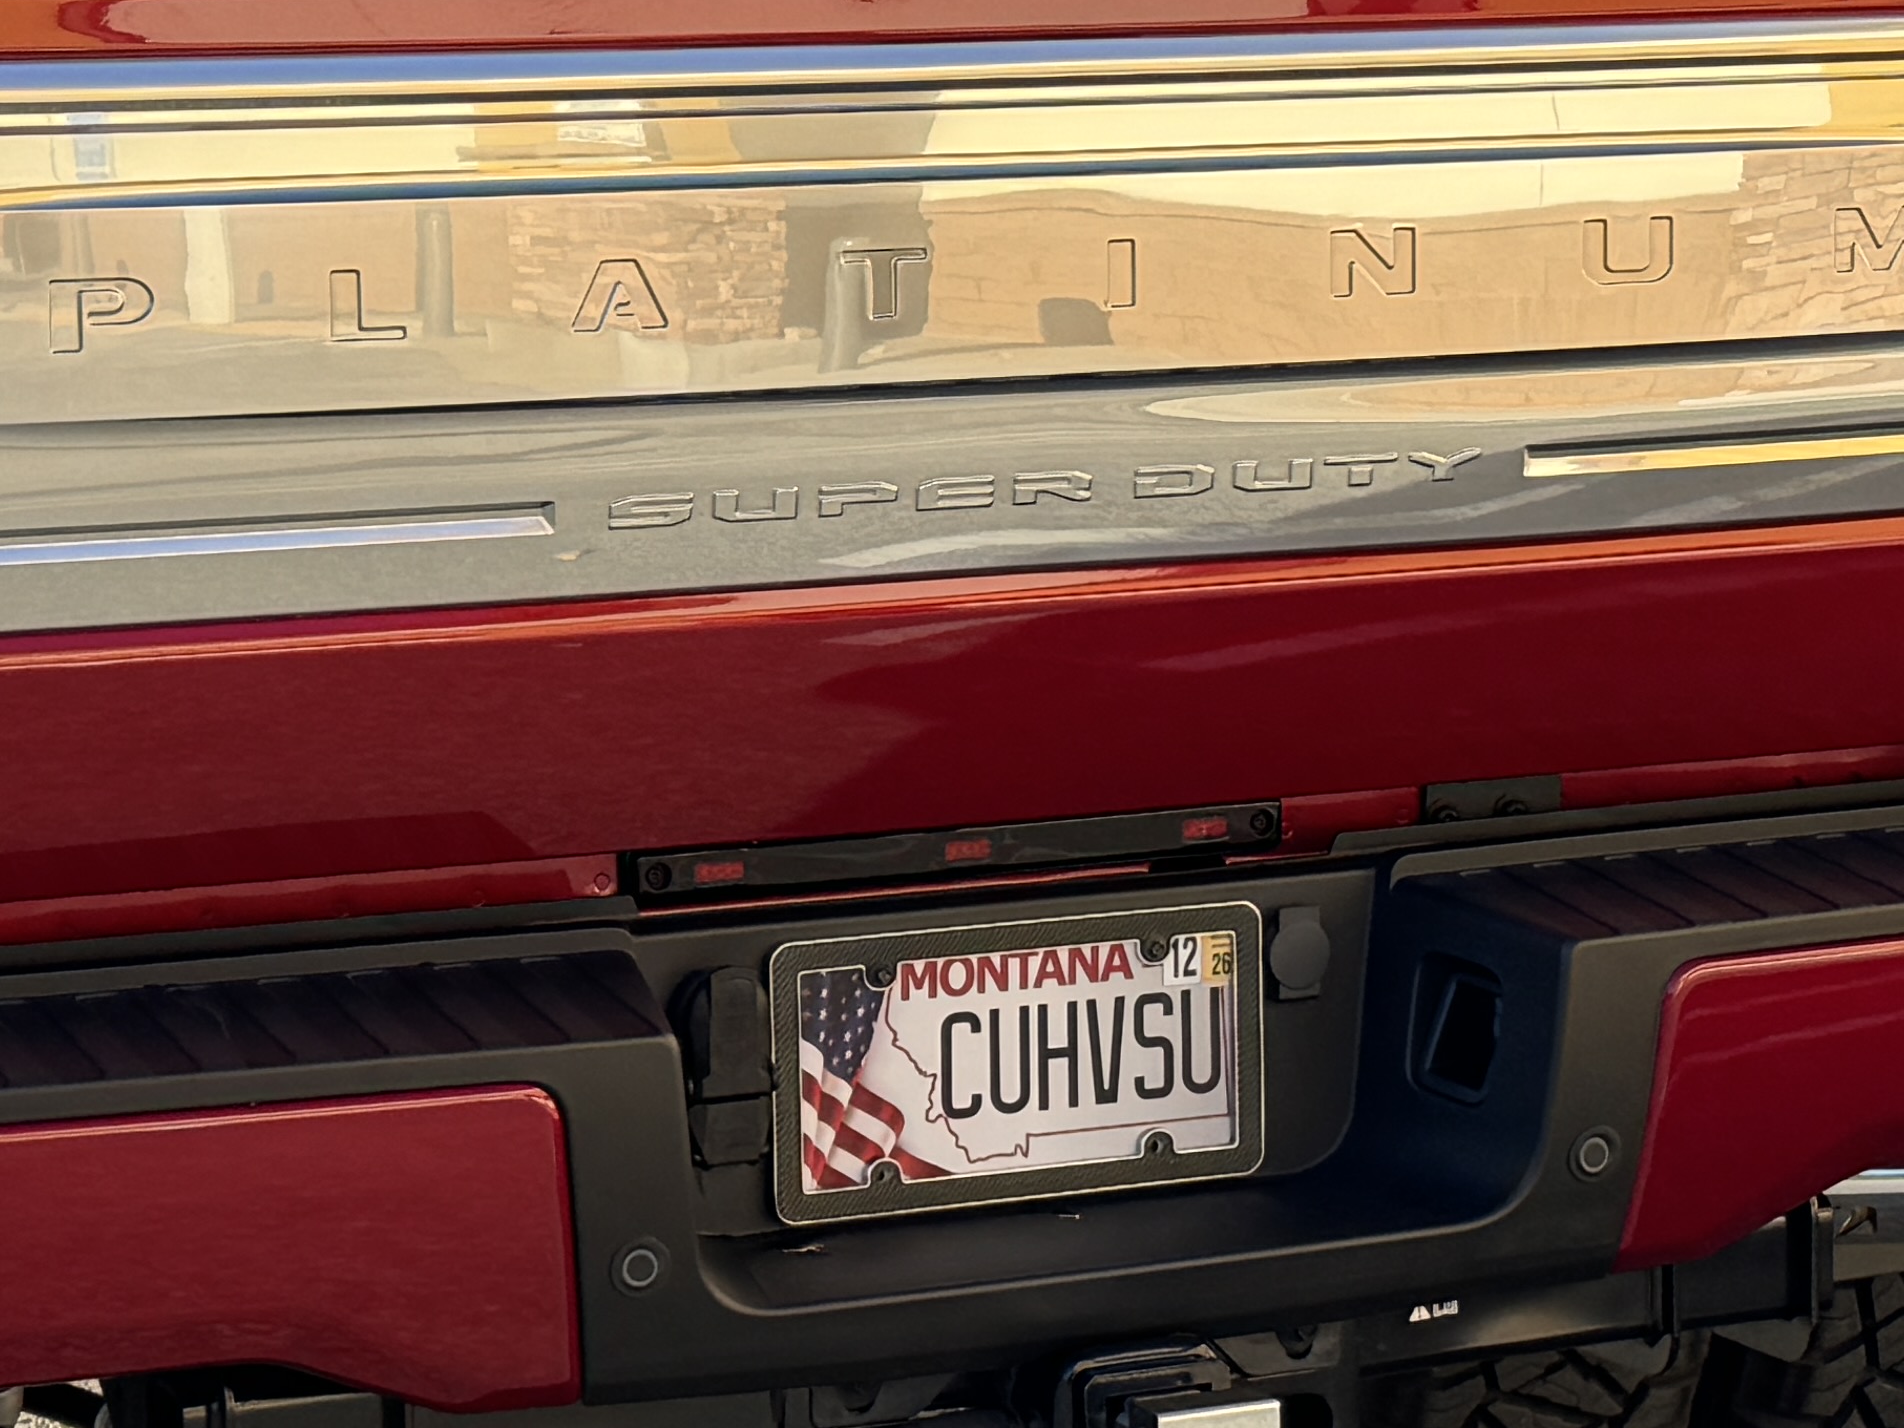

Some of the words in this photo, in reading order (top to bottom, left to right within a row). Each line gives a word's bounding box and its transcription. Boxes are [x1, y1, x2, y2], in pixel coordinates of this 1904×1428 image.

[606, 468, 1094, 532] SUPER
[1132, 444, 1485, 502] DUTY
[899, 942, 1135, 1002] MONTANA
[1171, 935, 1198, 979] 12
[1211, 951, 1232, 976] 26
[940, 986, 1222, 1120] CUHVSU
